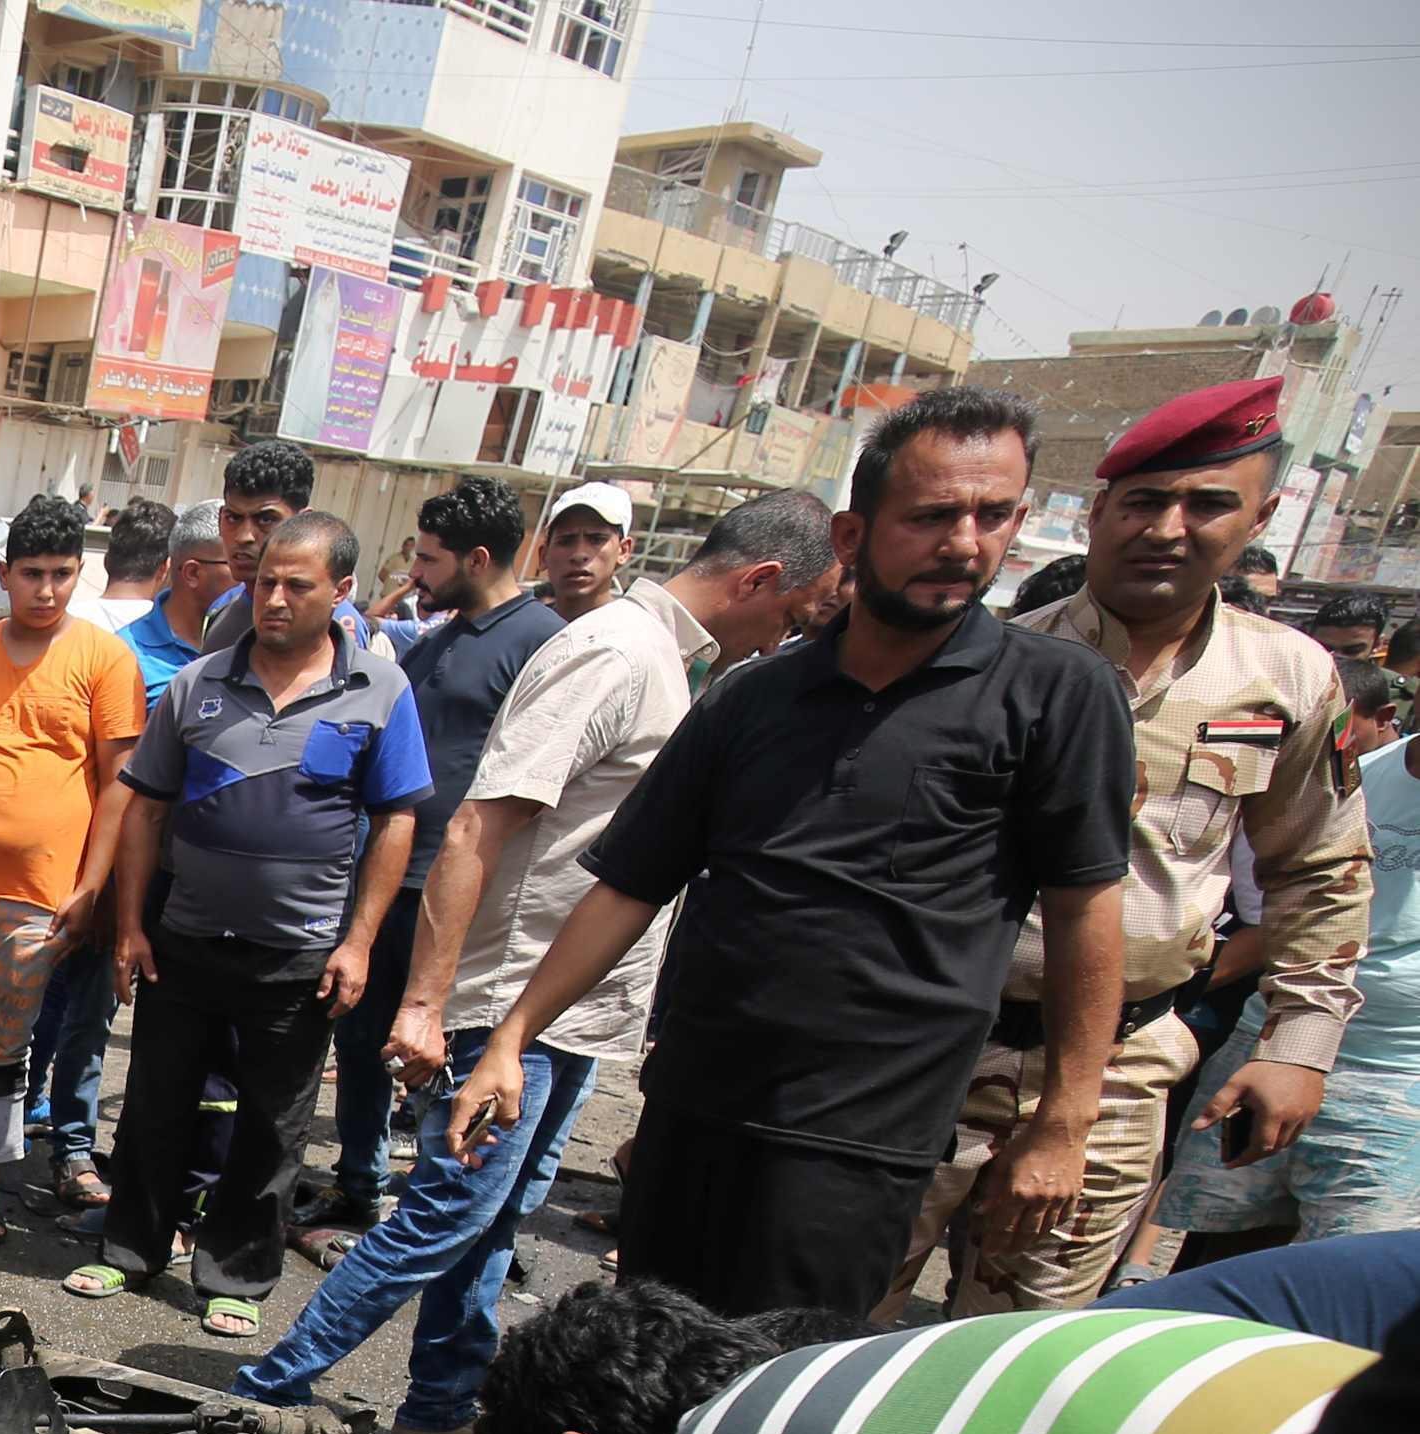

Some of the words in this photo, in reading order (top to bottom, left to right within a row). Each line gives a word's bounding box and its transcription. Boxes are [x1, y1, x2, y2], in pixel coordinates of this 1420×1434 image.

[251, 124, 292, 152] الرحمن
[287, 128, 310, 160] عيادة
[204, 245, 236, 277] عطور
[411, 340, 519, 392] صيدلية
